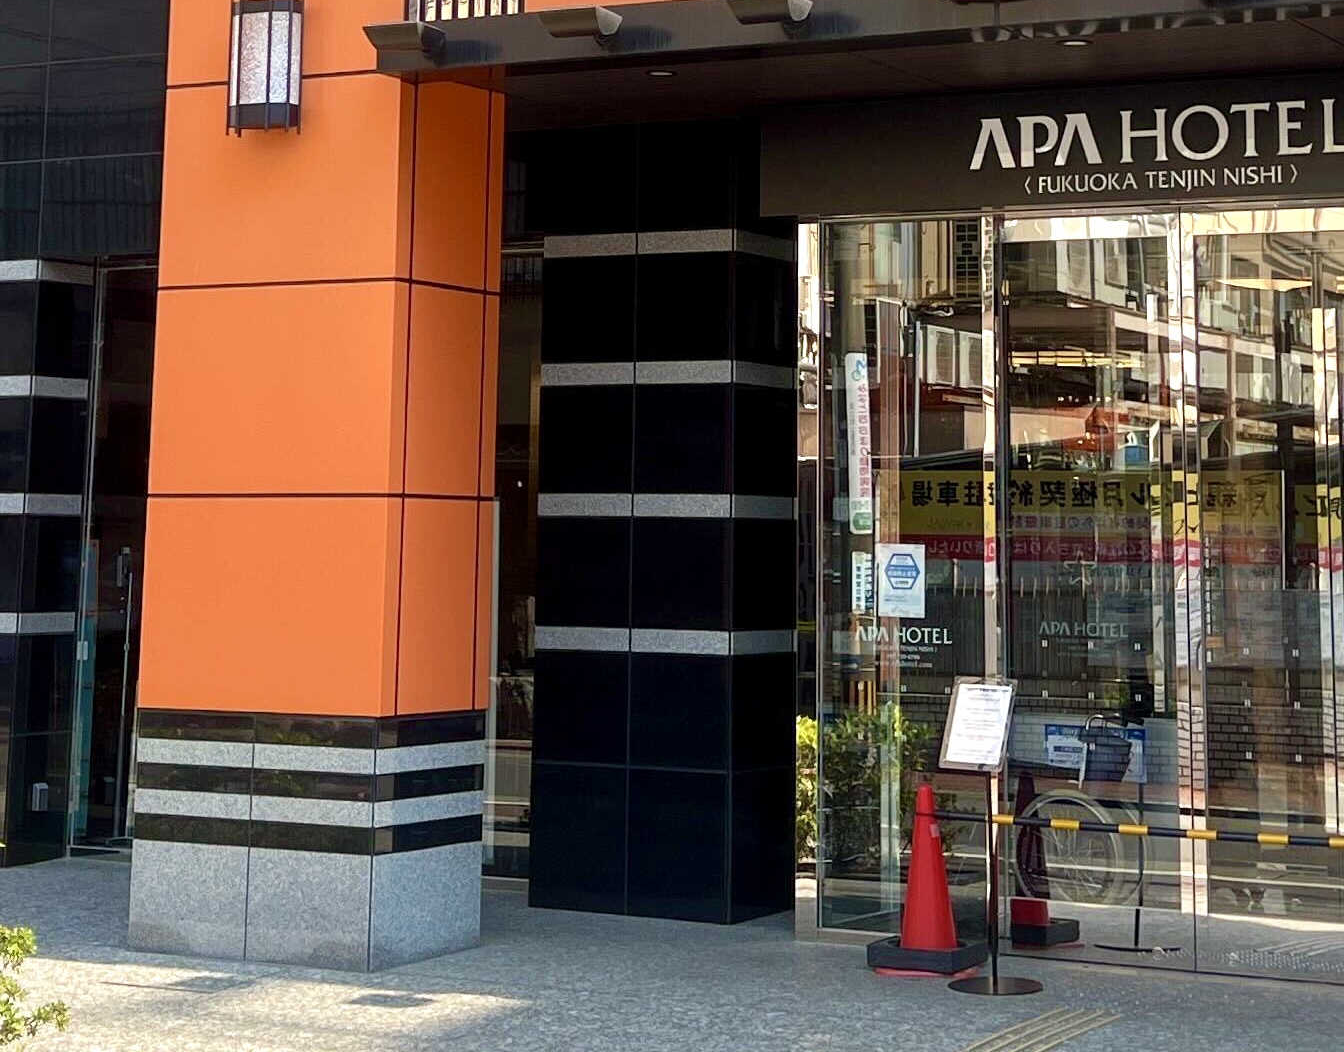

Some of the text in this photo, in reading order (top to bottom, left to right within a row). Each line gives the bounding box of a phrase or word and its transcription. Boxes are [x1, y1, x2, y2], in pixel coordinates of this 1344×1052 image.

[970, 113, 1102, 170] APA
[1038, 172, 1138, 194] FUKUOKA
[1145, 168, 1216, 192] TENJIN
[1223, 165, 1282, 187] NISHI
[855, 626, 953, 645] APA HOTEL
[1039, 621, 1129, 638] APA HOTEL
